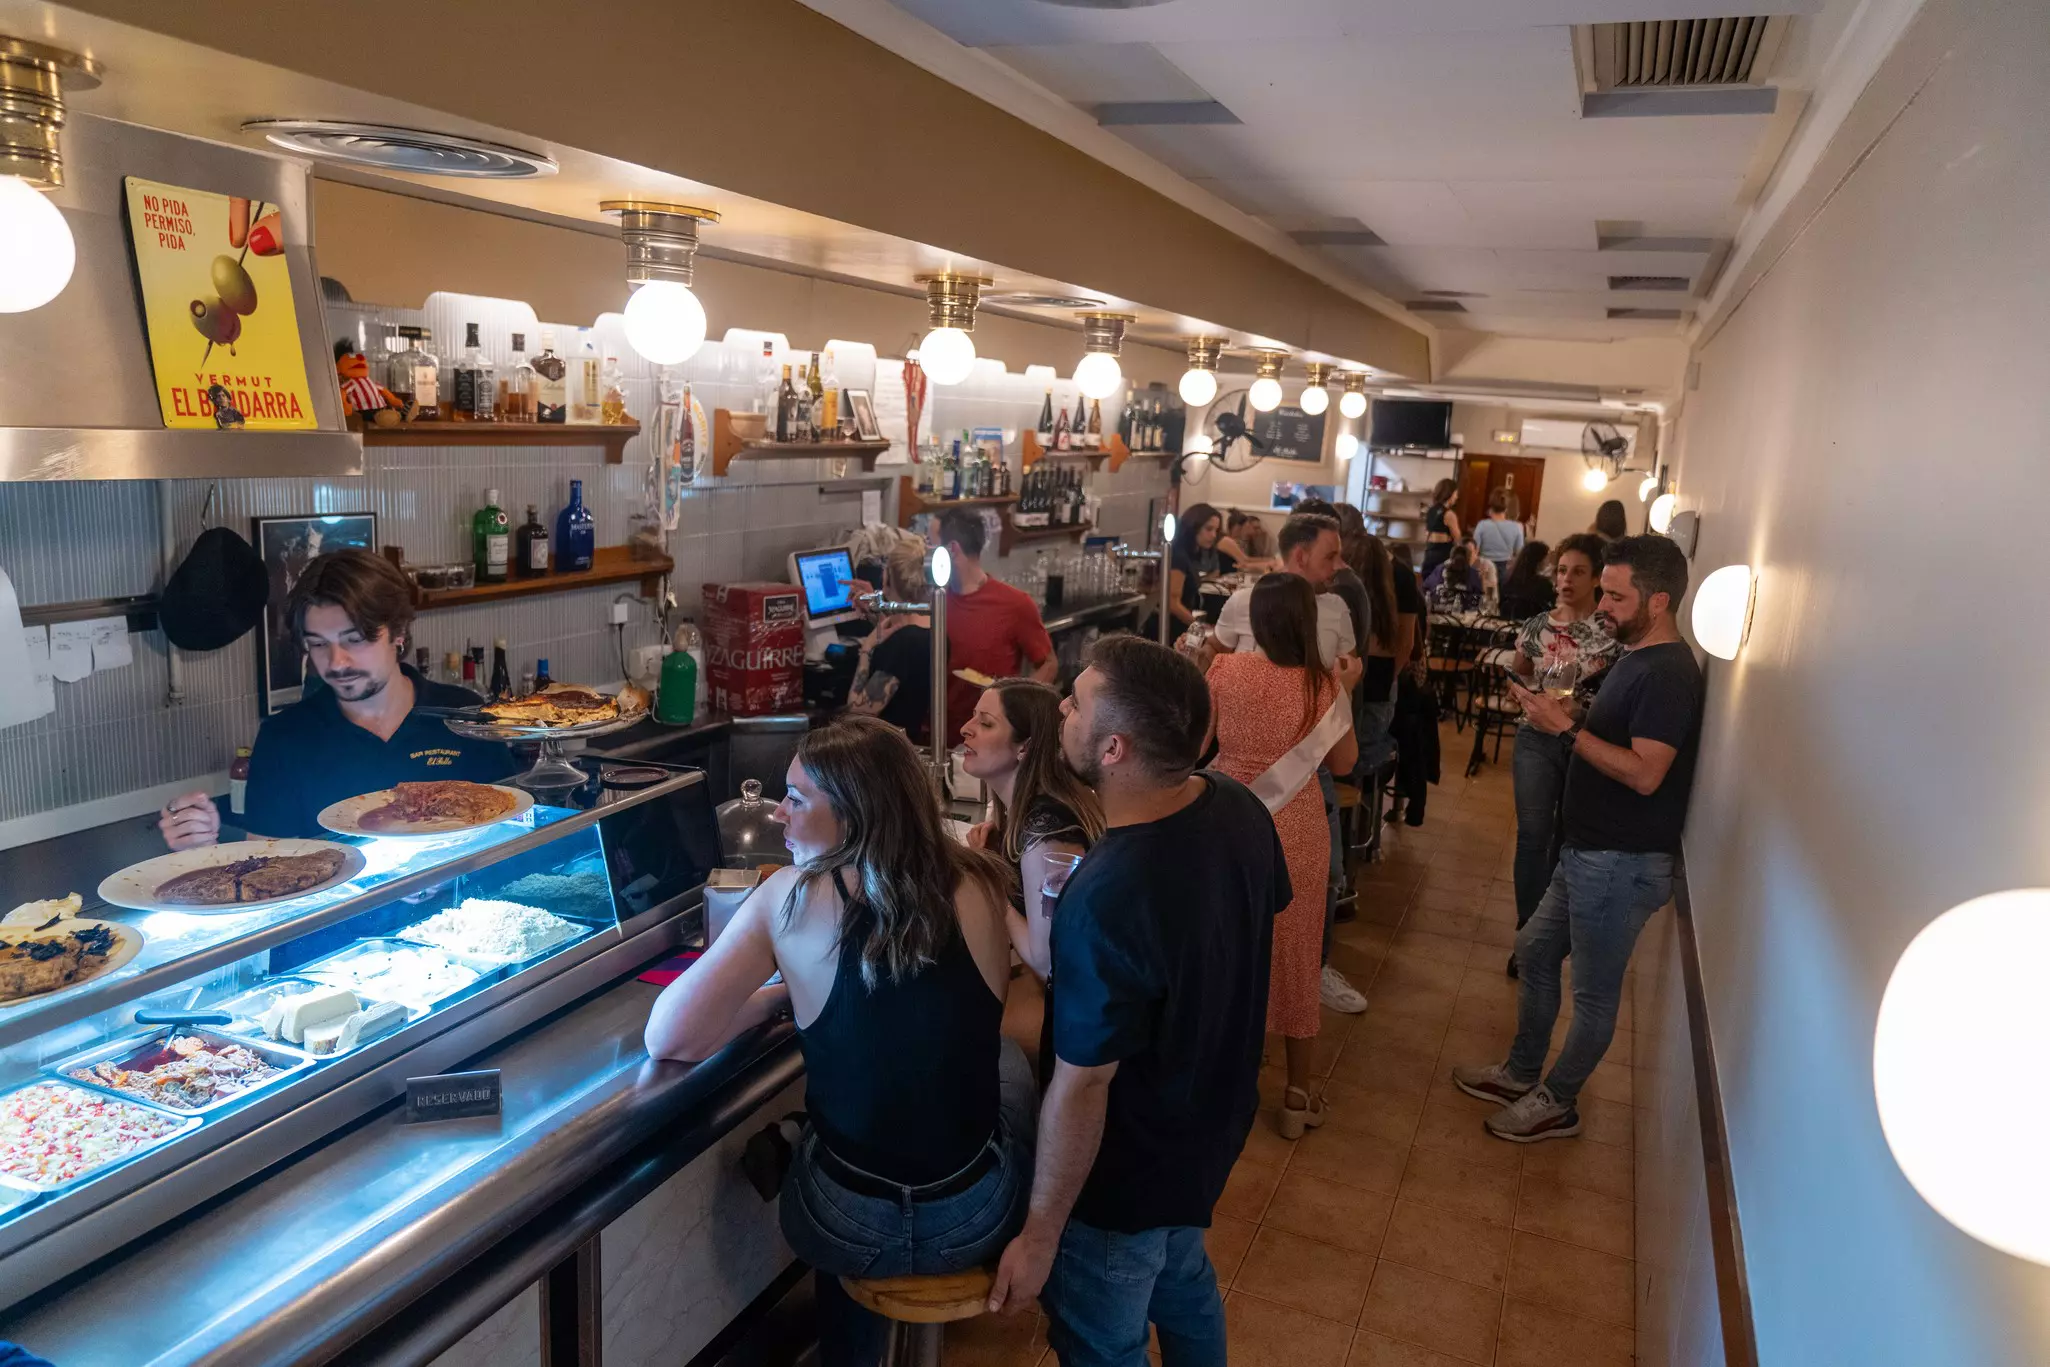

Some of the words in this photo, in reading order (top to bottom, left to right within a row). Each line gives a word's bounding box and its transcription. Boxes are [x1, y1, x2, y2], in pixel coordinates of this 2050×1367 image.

[143, 194, 160, 212] NO
[162, 198, 189, 217] PIDA
[144, 212, 196, 237] PERMISO,
[158, 232, 186, 251] PIDA
[195, 372, 272, 388] VERMUT
[171, 387, 198, 417] EL
[197, 388, 304, 419] BNDARRA
[416, 1087, 491, 1108] RESERVADO
